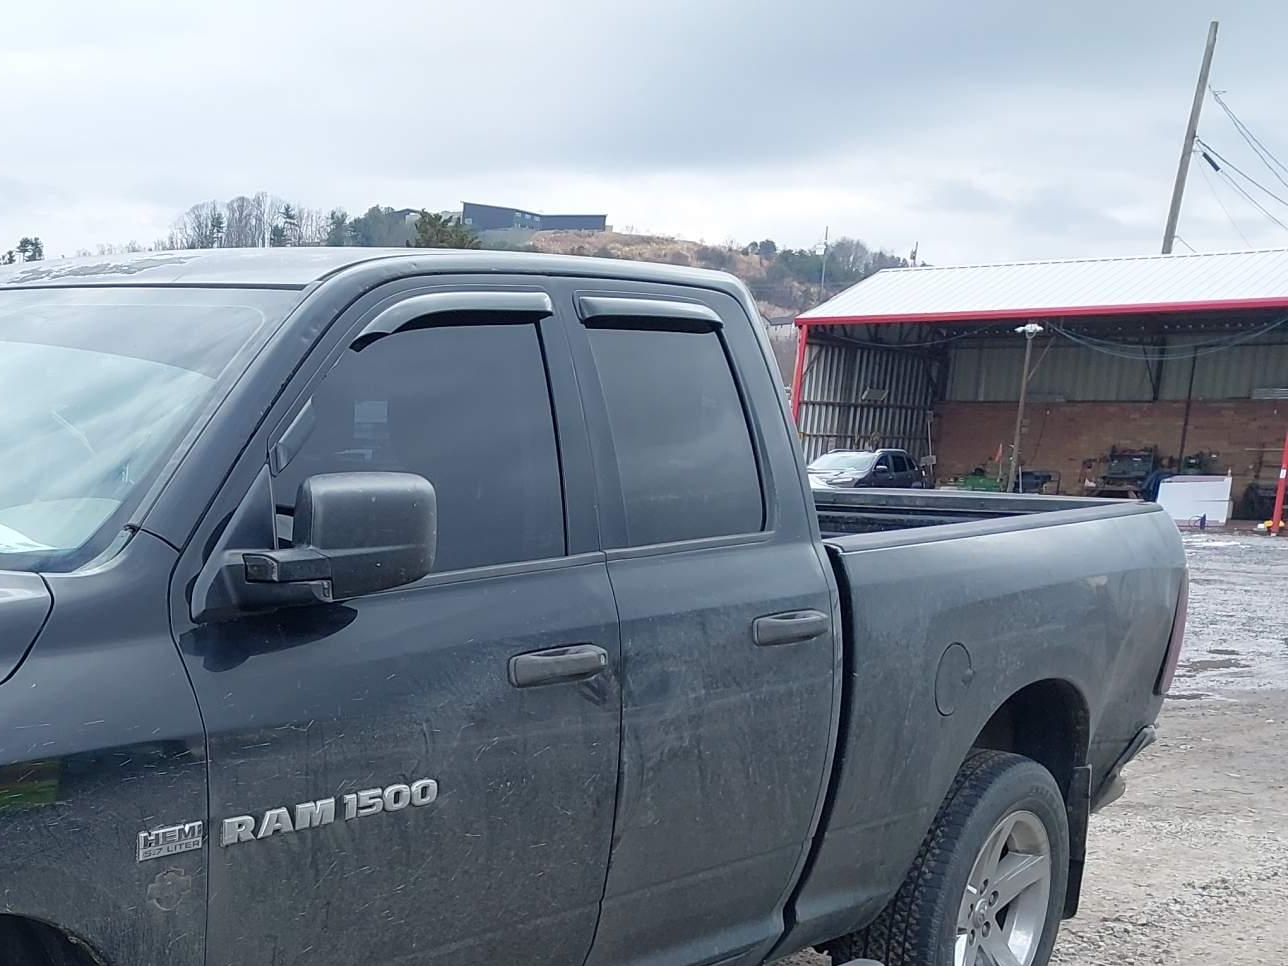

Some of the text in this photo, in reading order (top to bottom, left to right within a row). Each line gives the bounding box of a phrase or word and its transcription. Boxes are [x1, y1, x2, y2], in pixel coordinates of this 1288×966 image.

[220, 779, 439, 847] RAM 1500
[142, 839, 201, 859] 5.7 LITER
